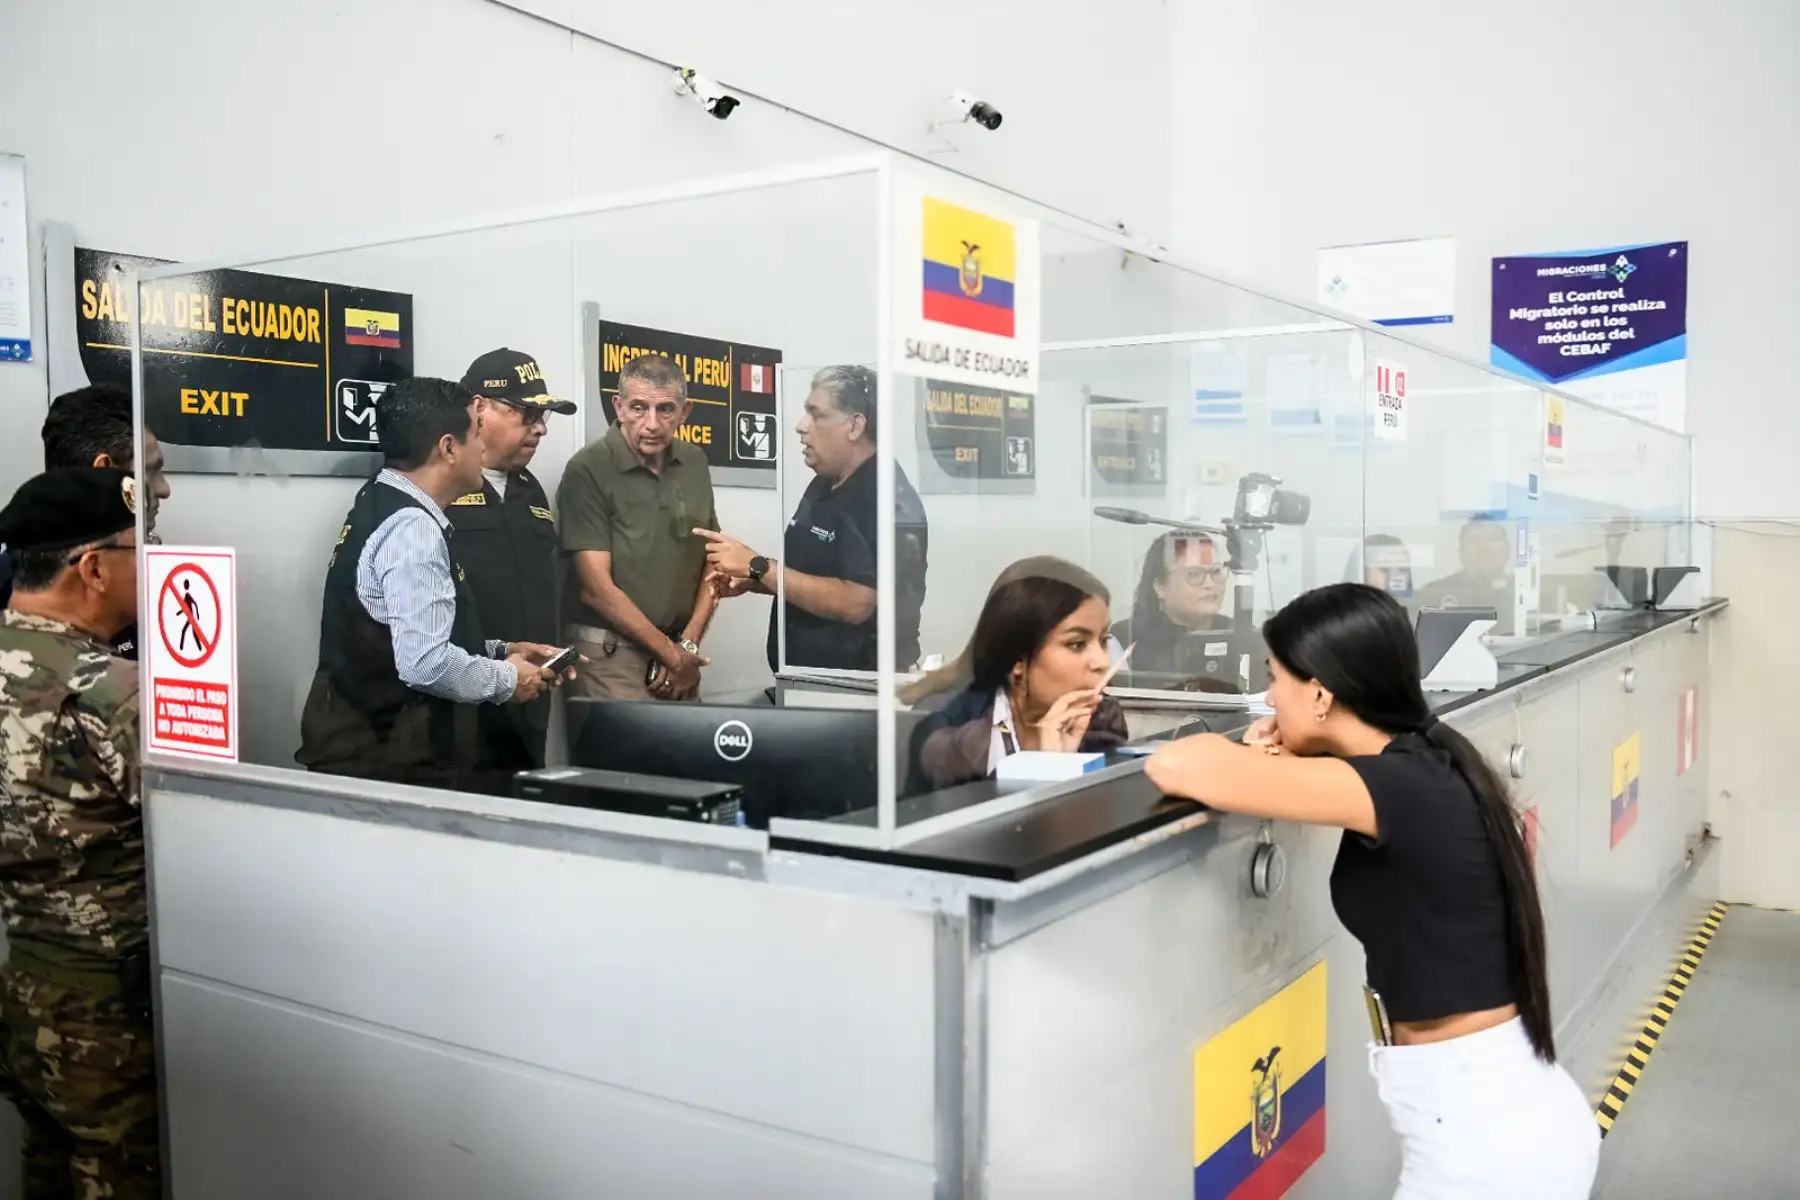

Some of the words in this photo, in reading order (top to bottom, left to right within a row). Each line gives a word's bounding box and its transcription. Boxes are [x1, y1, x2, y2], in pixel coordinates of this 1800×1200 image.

[1537, 264, 1607, 277] MIGRACIONES
[1549, 292, 1564, 304] El
[1566, 287, 1625, 302] Control
[82, 279, 167, 326] SALDA
[174, 291, 217, 332] DEL
[222, 297, 321, 344] ECUADOR
[1509, 303, 1588, 321] Migratorio
[1590, 303, 1609, 314] se
[1612, 299, 1666, 313] realiza
[1544, 318, 1578, 331] solo
[1580, 317, 1600, 329] en
[1603, 315, 1628, 327] los
[1537, 329, 1606, 344] módulos
[1608, 327, 1635, 340] del
[1559, 342, 1612, 356] CEBAF
[904, 337, 949, 364] SALIDA
[954, 347, 971, 371] DE
[974, 352, 1030, 379] ECUADOR
[693, 355, 730, 388] PERÚ
[483, 379, 508, 388] PERU
[180, 388, 250, 418] EXIT
[925, 388, 953, 413] SALIDA
[968, 393, 1002, 418] ECUADOR
[1379, 393, 1403, 411] ENTRADA
[955, 446, 979, 463] EXIT
[719, 734, 748, 748] DELL
